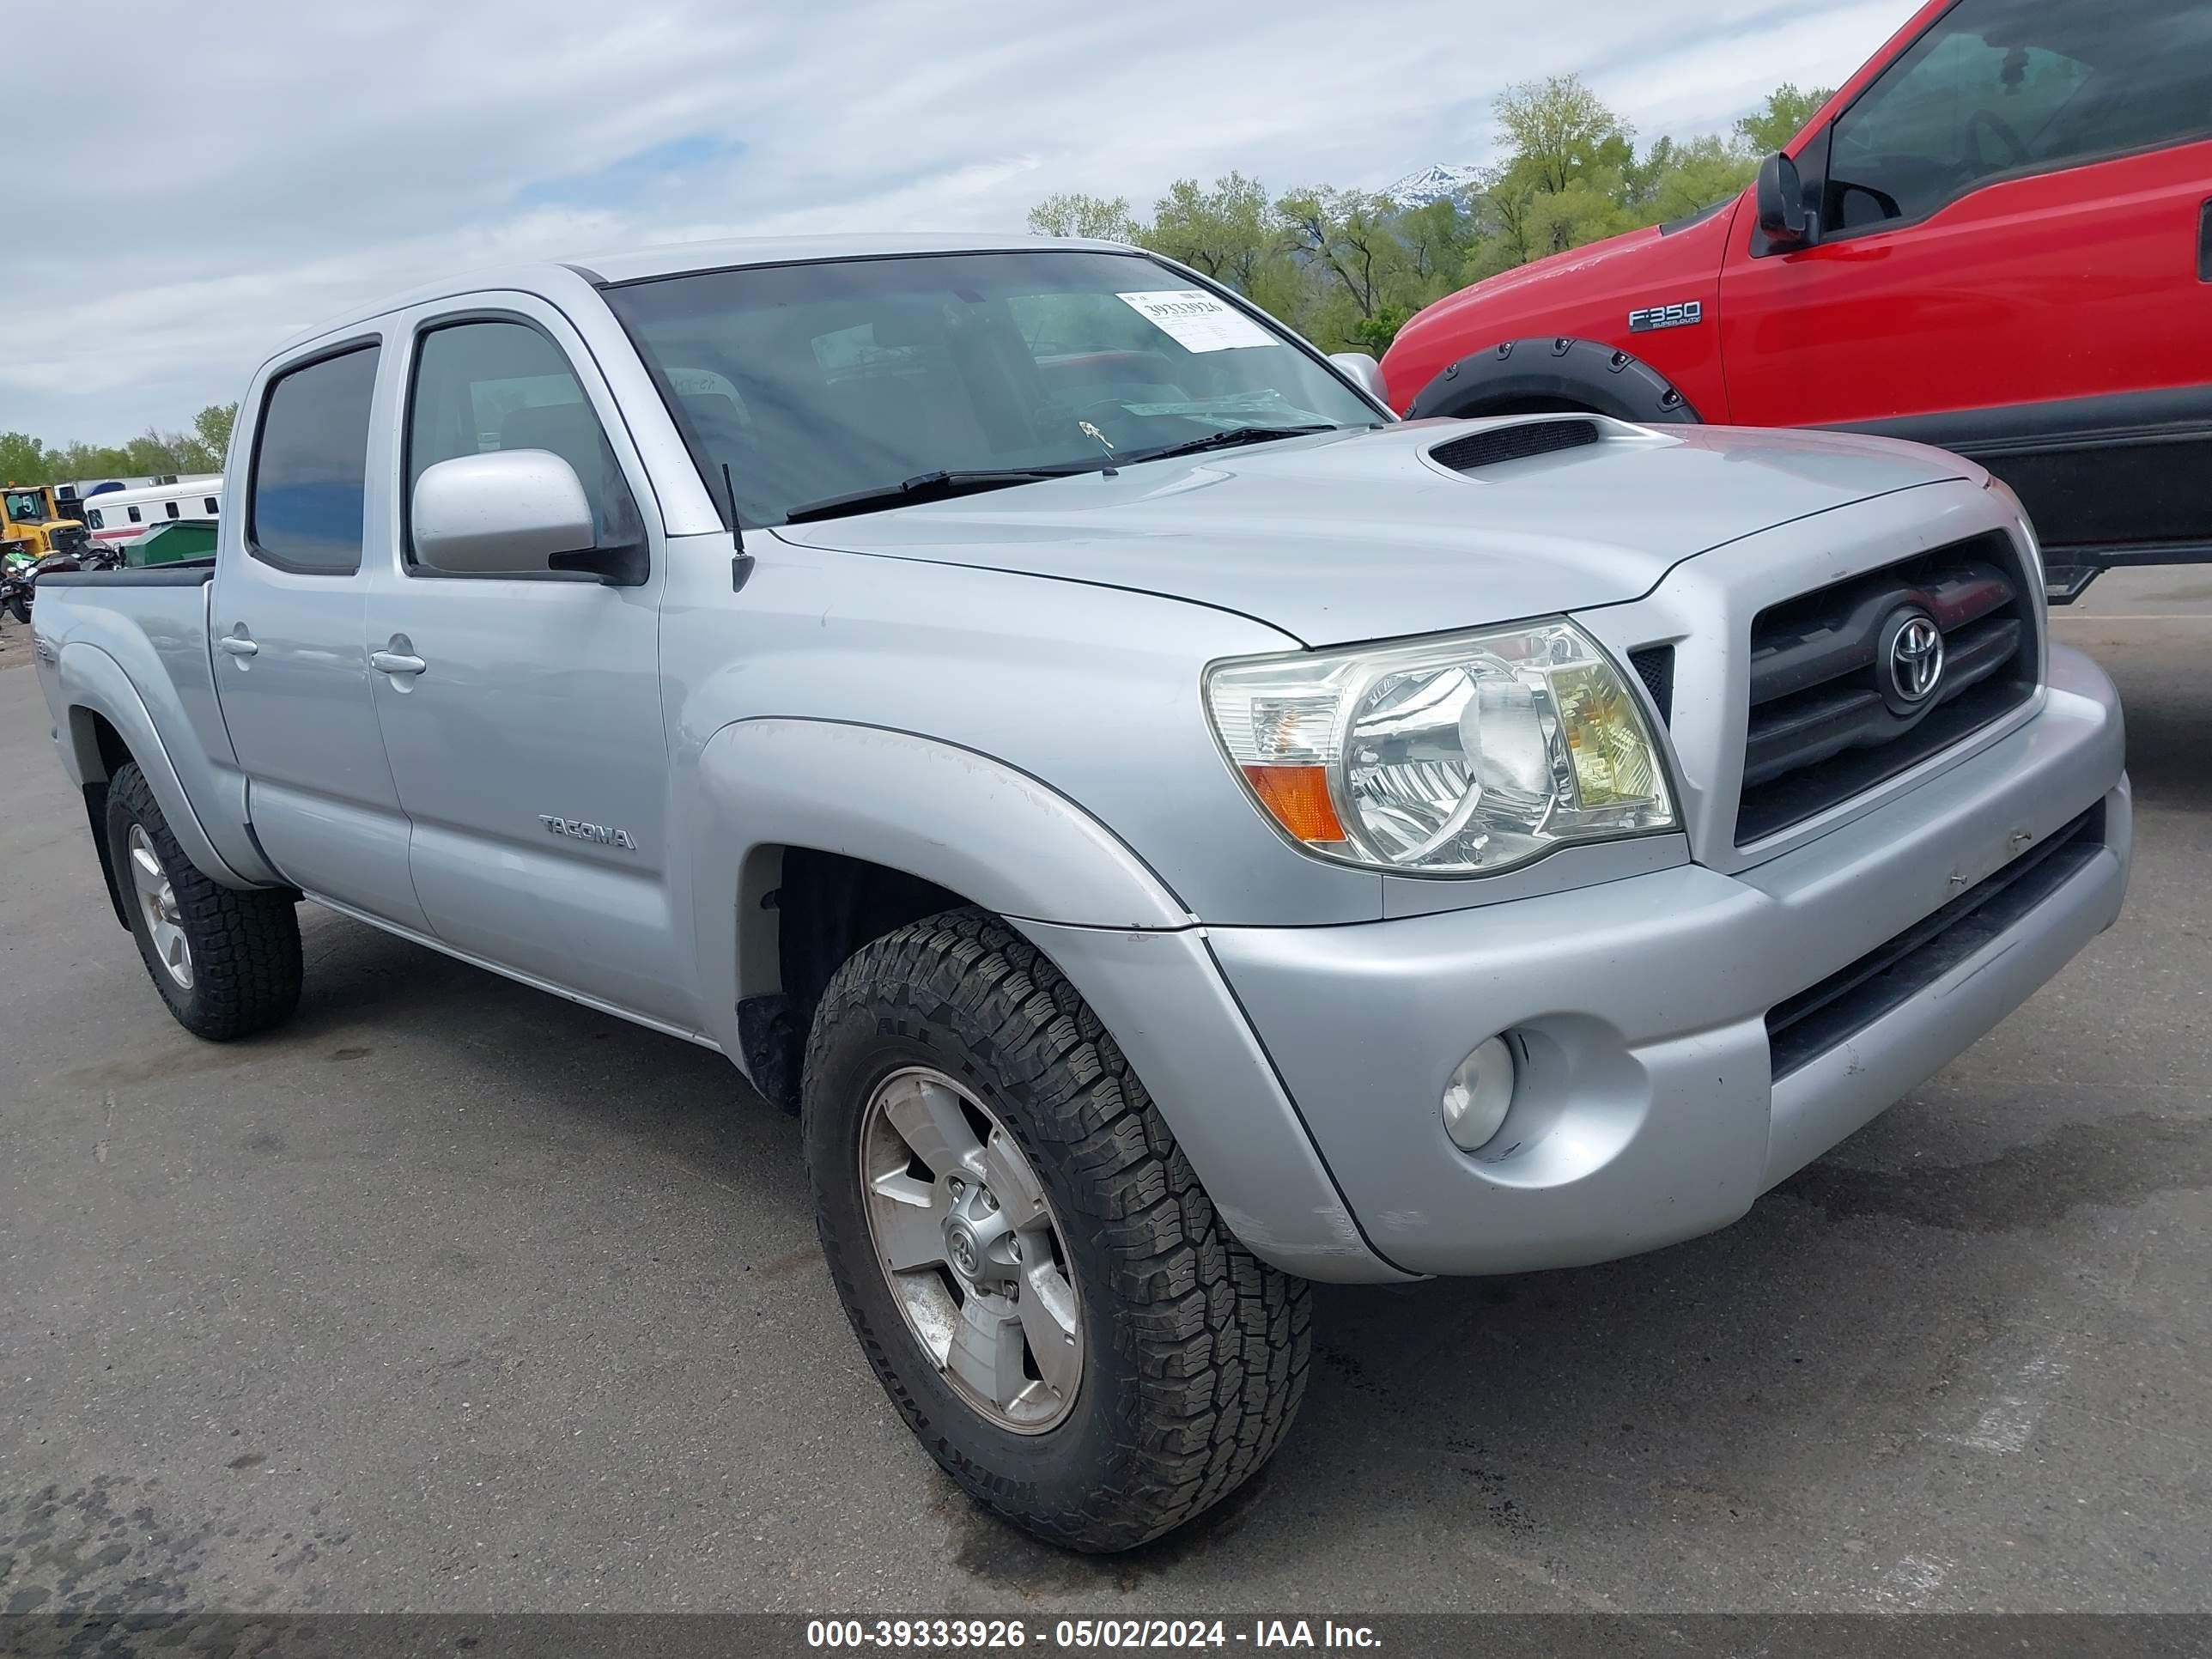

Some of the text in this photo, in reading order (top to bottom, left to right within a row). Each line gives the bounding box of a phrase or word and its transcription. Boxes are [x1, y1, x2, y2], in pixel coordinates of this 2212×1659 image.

[1144, 301, 1223, 316] 39333926
[1653, 319, 1678, 328] SUPER
[22, 495, 33, 512] 5
[537, 814, 638, 850] TACOMA
